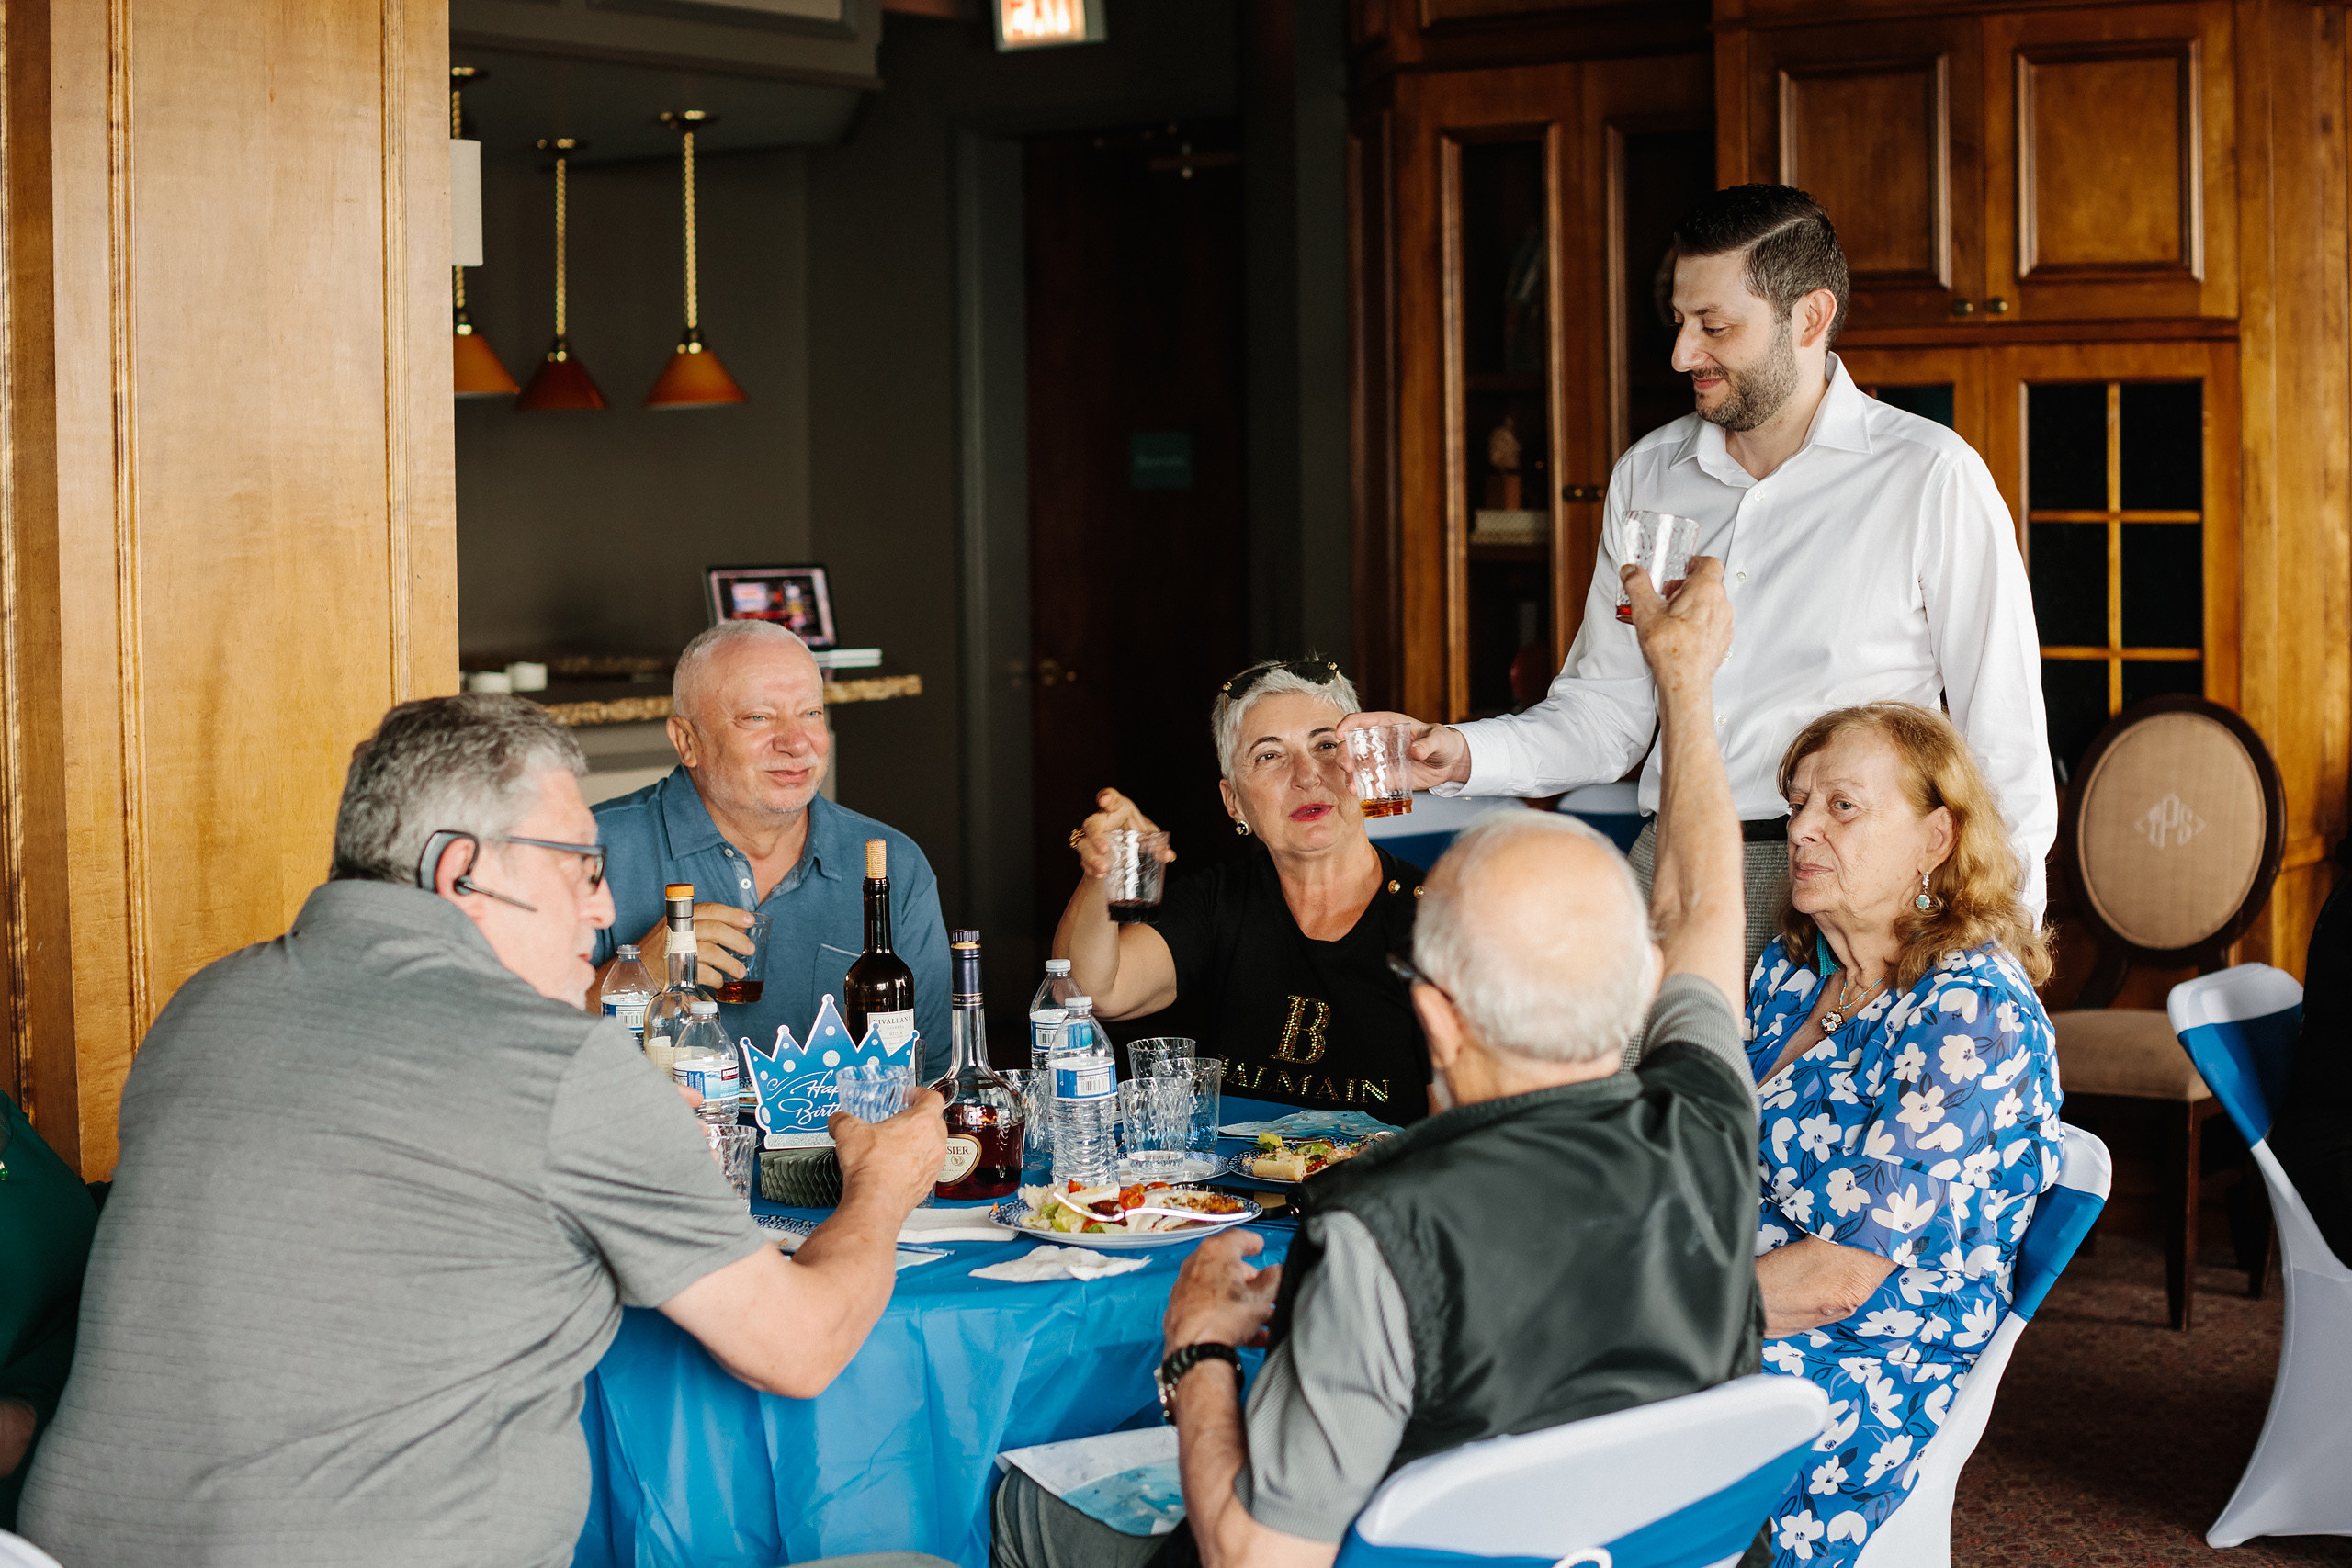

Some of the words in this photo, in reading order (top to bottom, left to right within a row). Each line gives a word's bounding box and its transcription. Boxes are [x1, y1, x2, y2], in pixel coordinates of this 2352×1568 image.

[1268, 995, 1331, 1065] B
[790, 1069, 840, 1100] Hap
[946, 1146, 969, 1155] SIER
